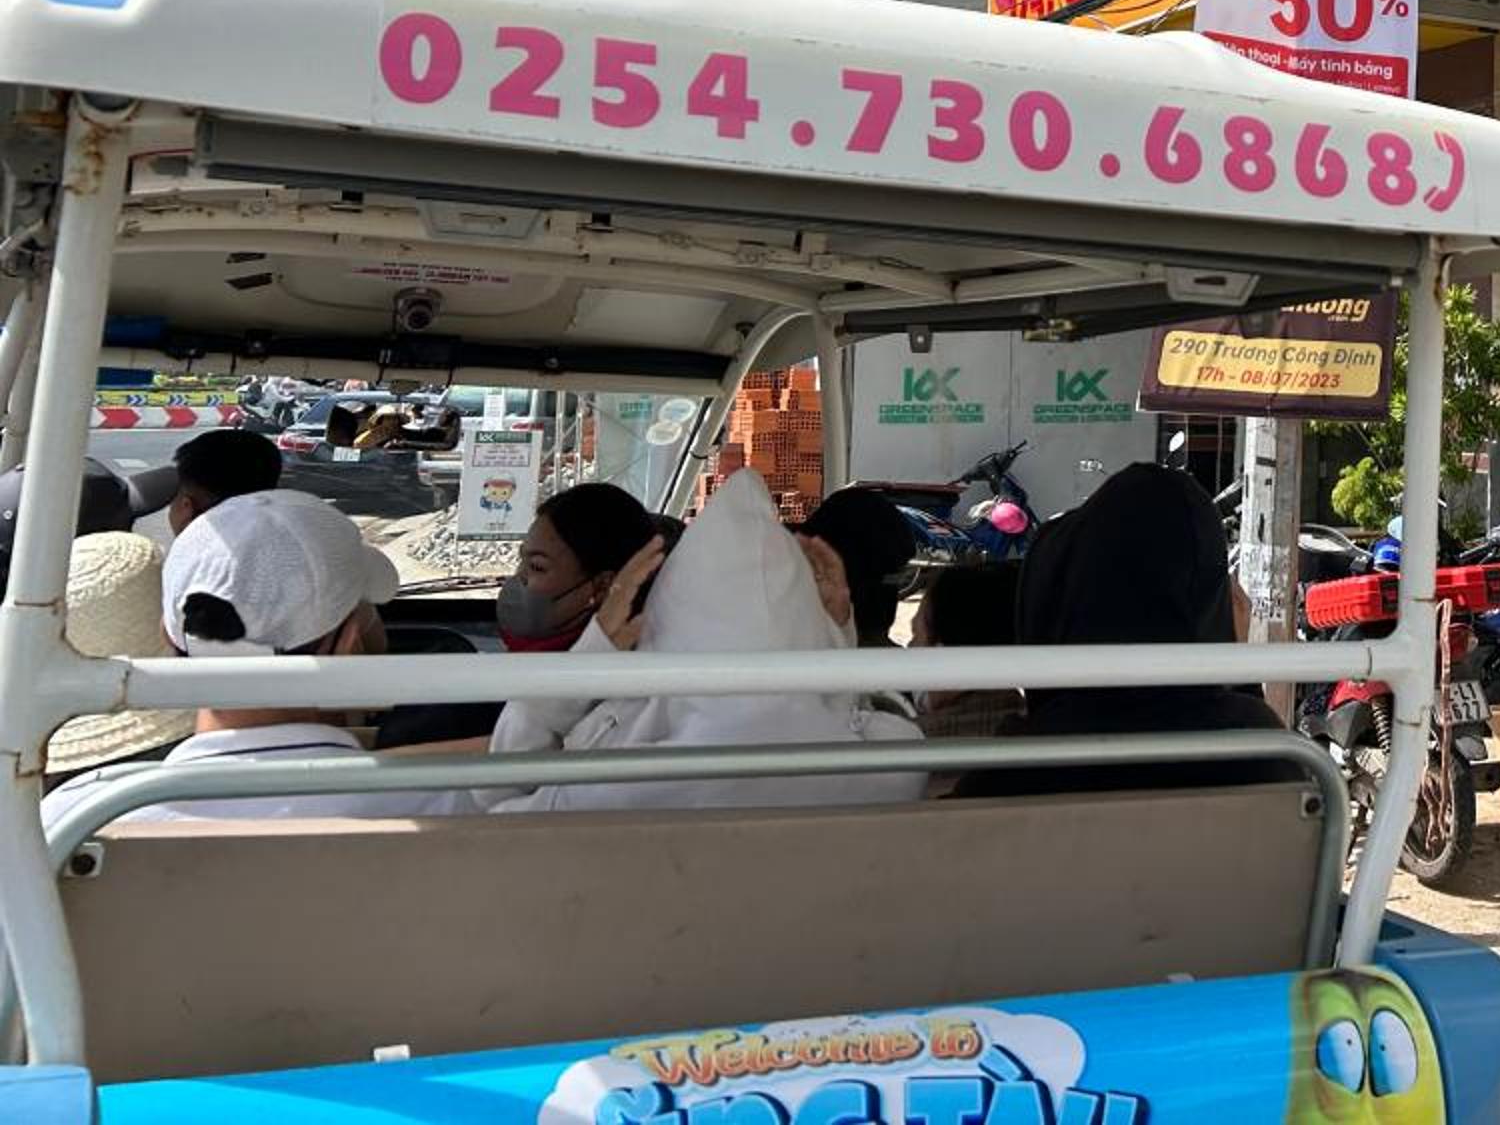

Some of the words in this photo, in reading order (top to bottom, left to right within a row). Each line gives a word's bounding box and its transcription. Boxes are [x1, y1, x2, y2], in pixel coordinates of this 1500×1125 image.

[1249, 46, 1281, 67] thoại
[1321, 54, 1351, 74] tính
[1354, 57, 1393, 80] bảng
[1170, 337, 1208, 356] 290
[1212, 341, 1277, 366] Trương
[1281, 346, 1327, 368] Công
[1333, 346, 1377, 370] Định
[1197, 366, 1225, 382] 17h
[1239, 369, 1342, 389] 08/07/2023
[609, 1025, 922, 1086] Welcome
